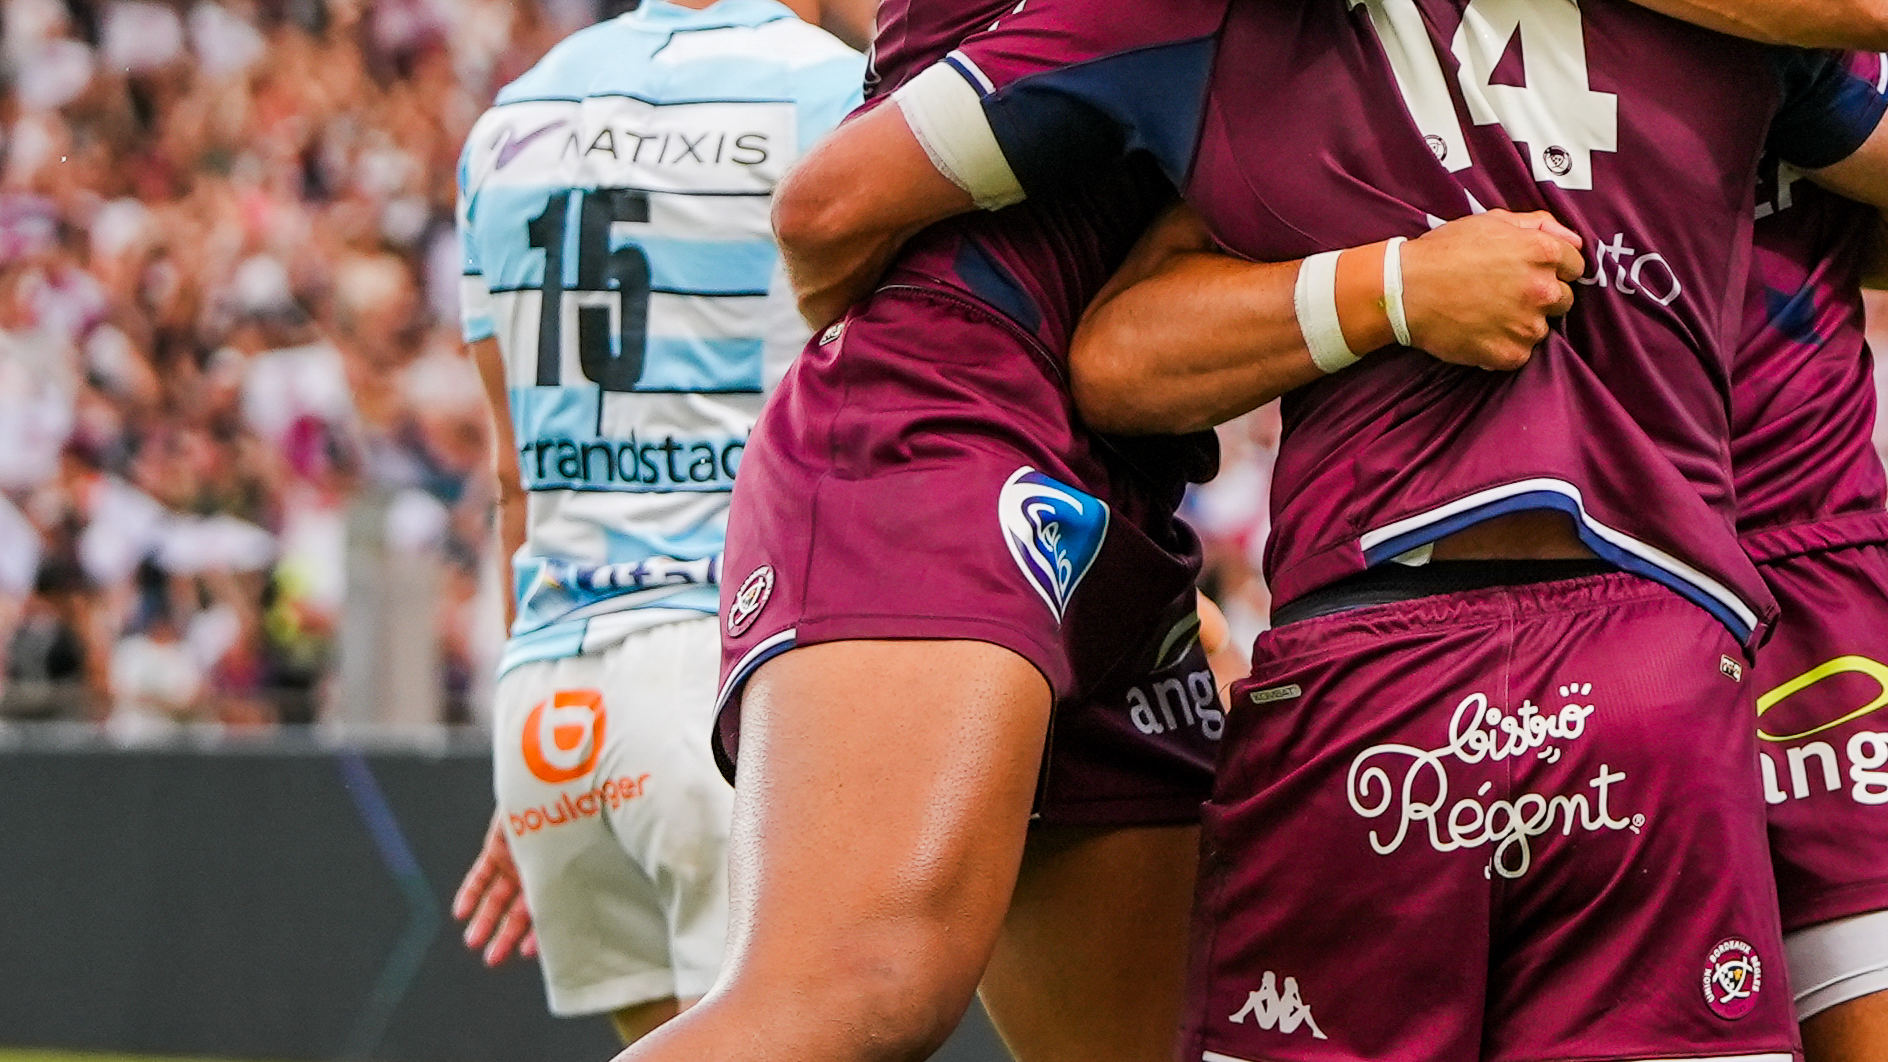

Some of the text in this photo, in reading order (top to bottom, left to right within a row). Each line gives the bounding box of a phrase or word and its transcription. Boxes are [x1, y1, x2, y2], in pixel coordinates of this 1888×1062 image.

[528, 188, 653, 392] 15
[1577, 232, 1682, 306] uto
[1126, 669, 1225, 740] ang
[1703, 967, 1716, 1004] UNION
[1709, 939, 1752, 964] BORDEAUX
